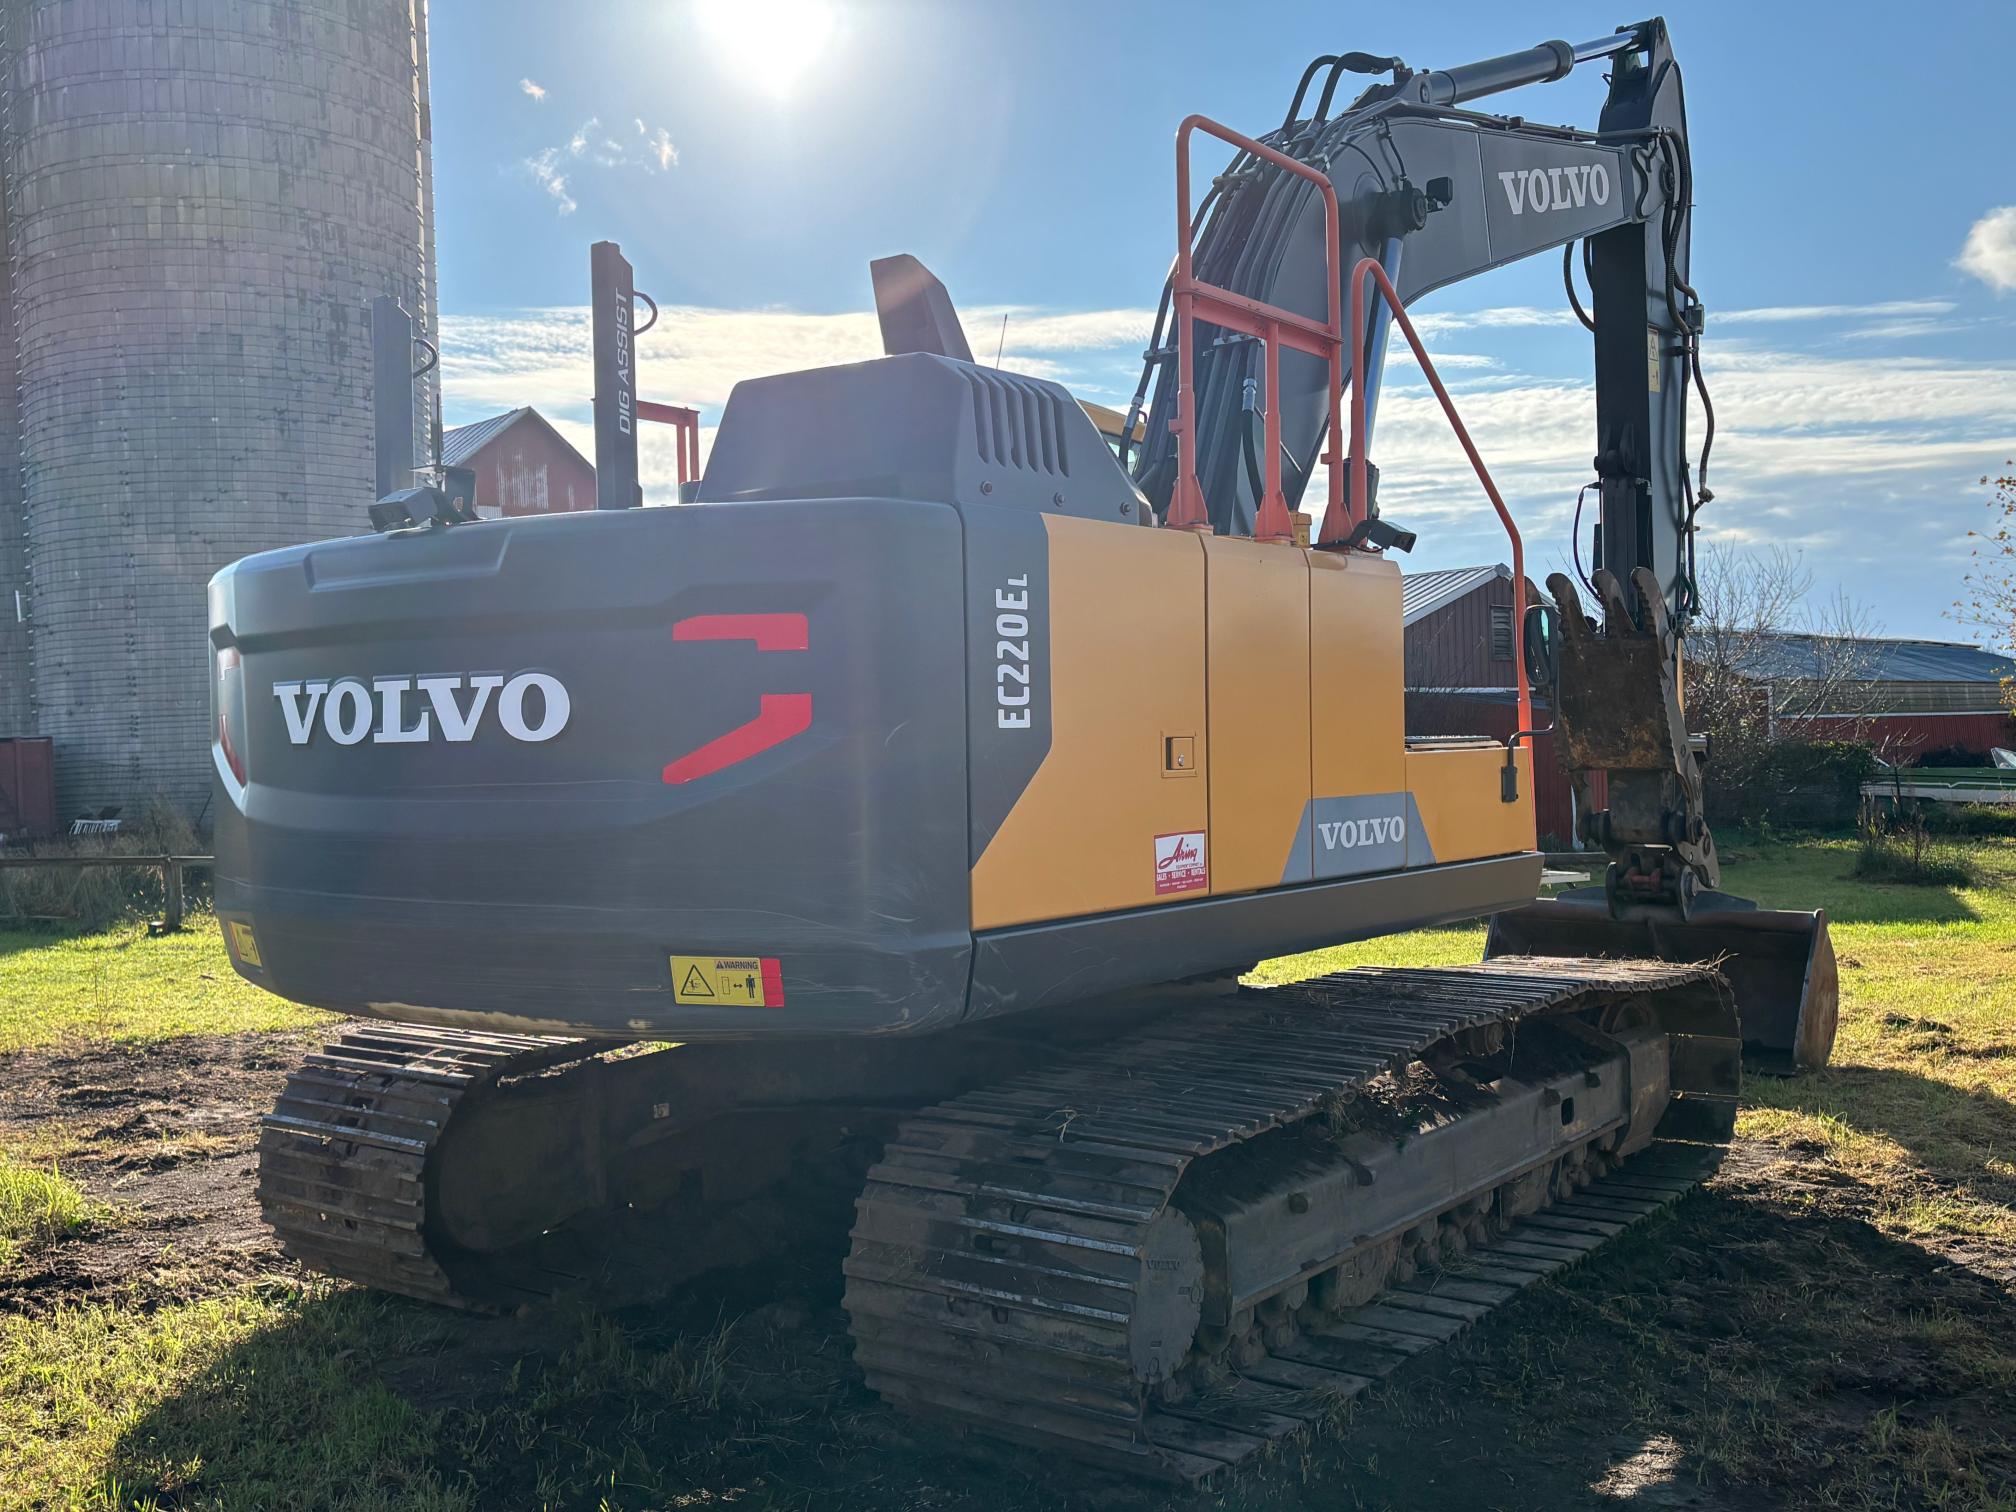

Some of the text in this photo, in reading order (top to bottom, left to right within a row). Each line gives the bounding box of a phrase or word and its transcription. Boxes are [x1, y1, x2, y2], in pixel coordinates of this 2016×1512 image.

[1498, 164, 1610, 215] VOLVO
[615, 287, 631, 436] DIG ASSIST
[996, 573, 1031, 729] EC220EL
[273, 673, 571, 746] VOLVO
[1318, 816, 1405, 850] VOLVO
[723, 961, 759, 970] WARNING
